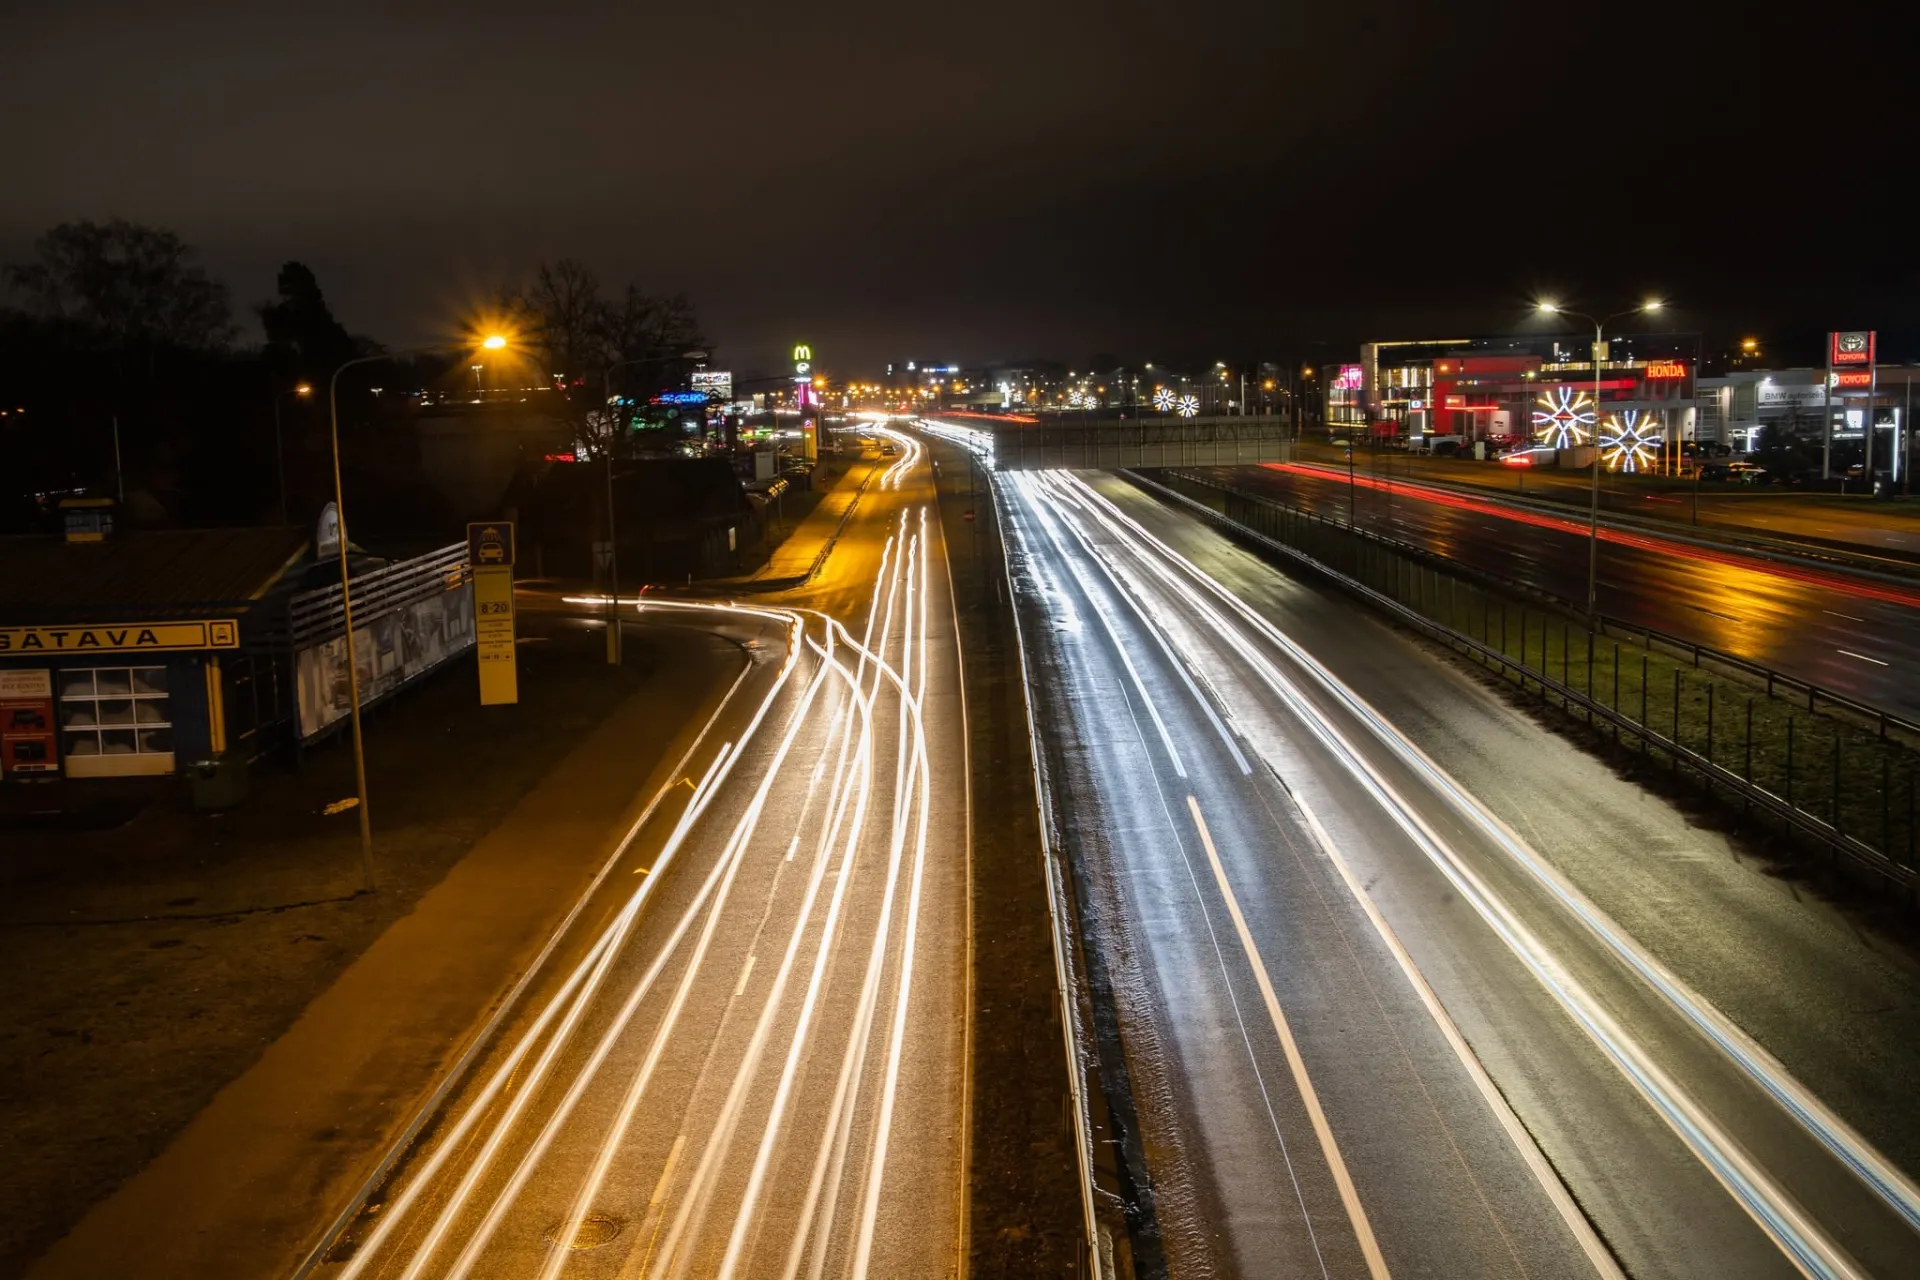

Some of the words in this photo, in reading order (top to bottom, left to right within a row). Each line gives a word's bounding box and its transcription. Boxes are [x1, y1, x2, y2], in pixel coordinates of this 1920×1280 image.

[1838, 353, 1866, 361] TOYOTA
[1647, 364, 1686, 377] HONDA
[1839, 374, 1871, 385] TOYOTA
[1764, 391, 1787, 400] BMW
